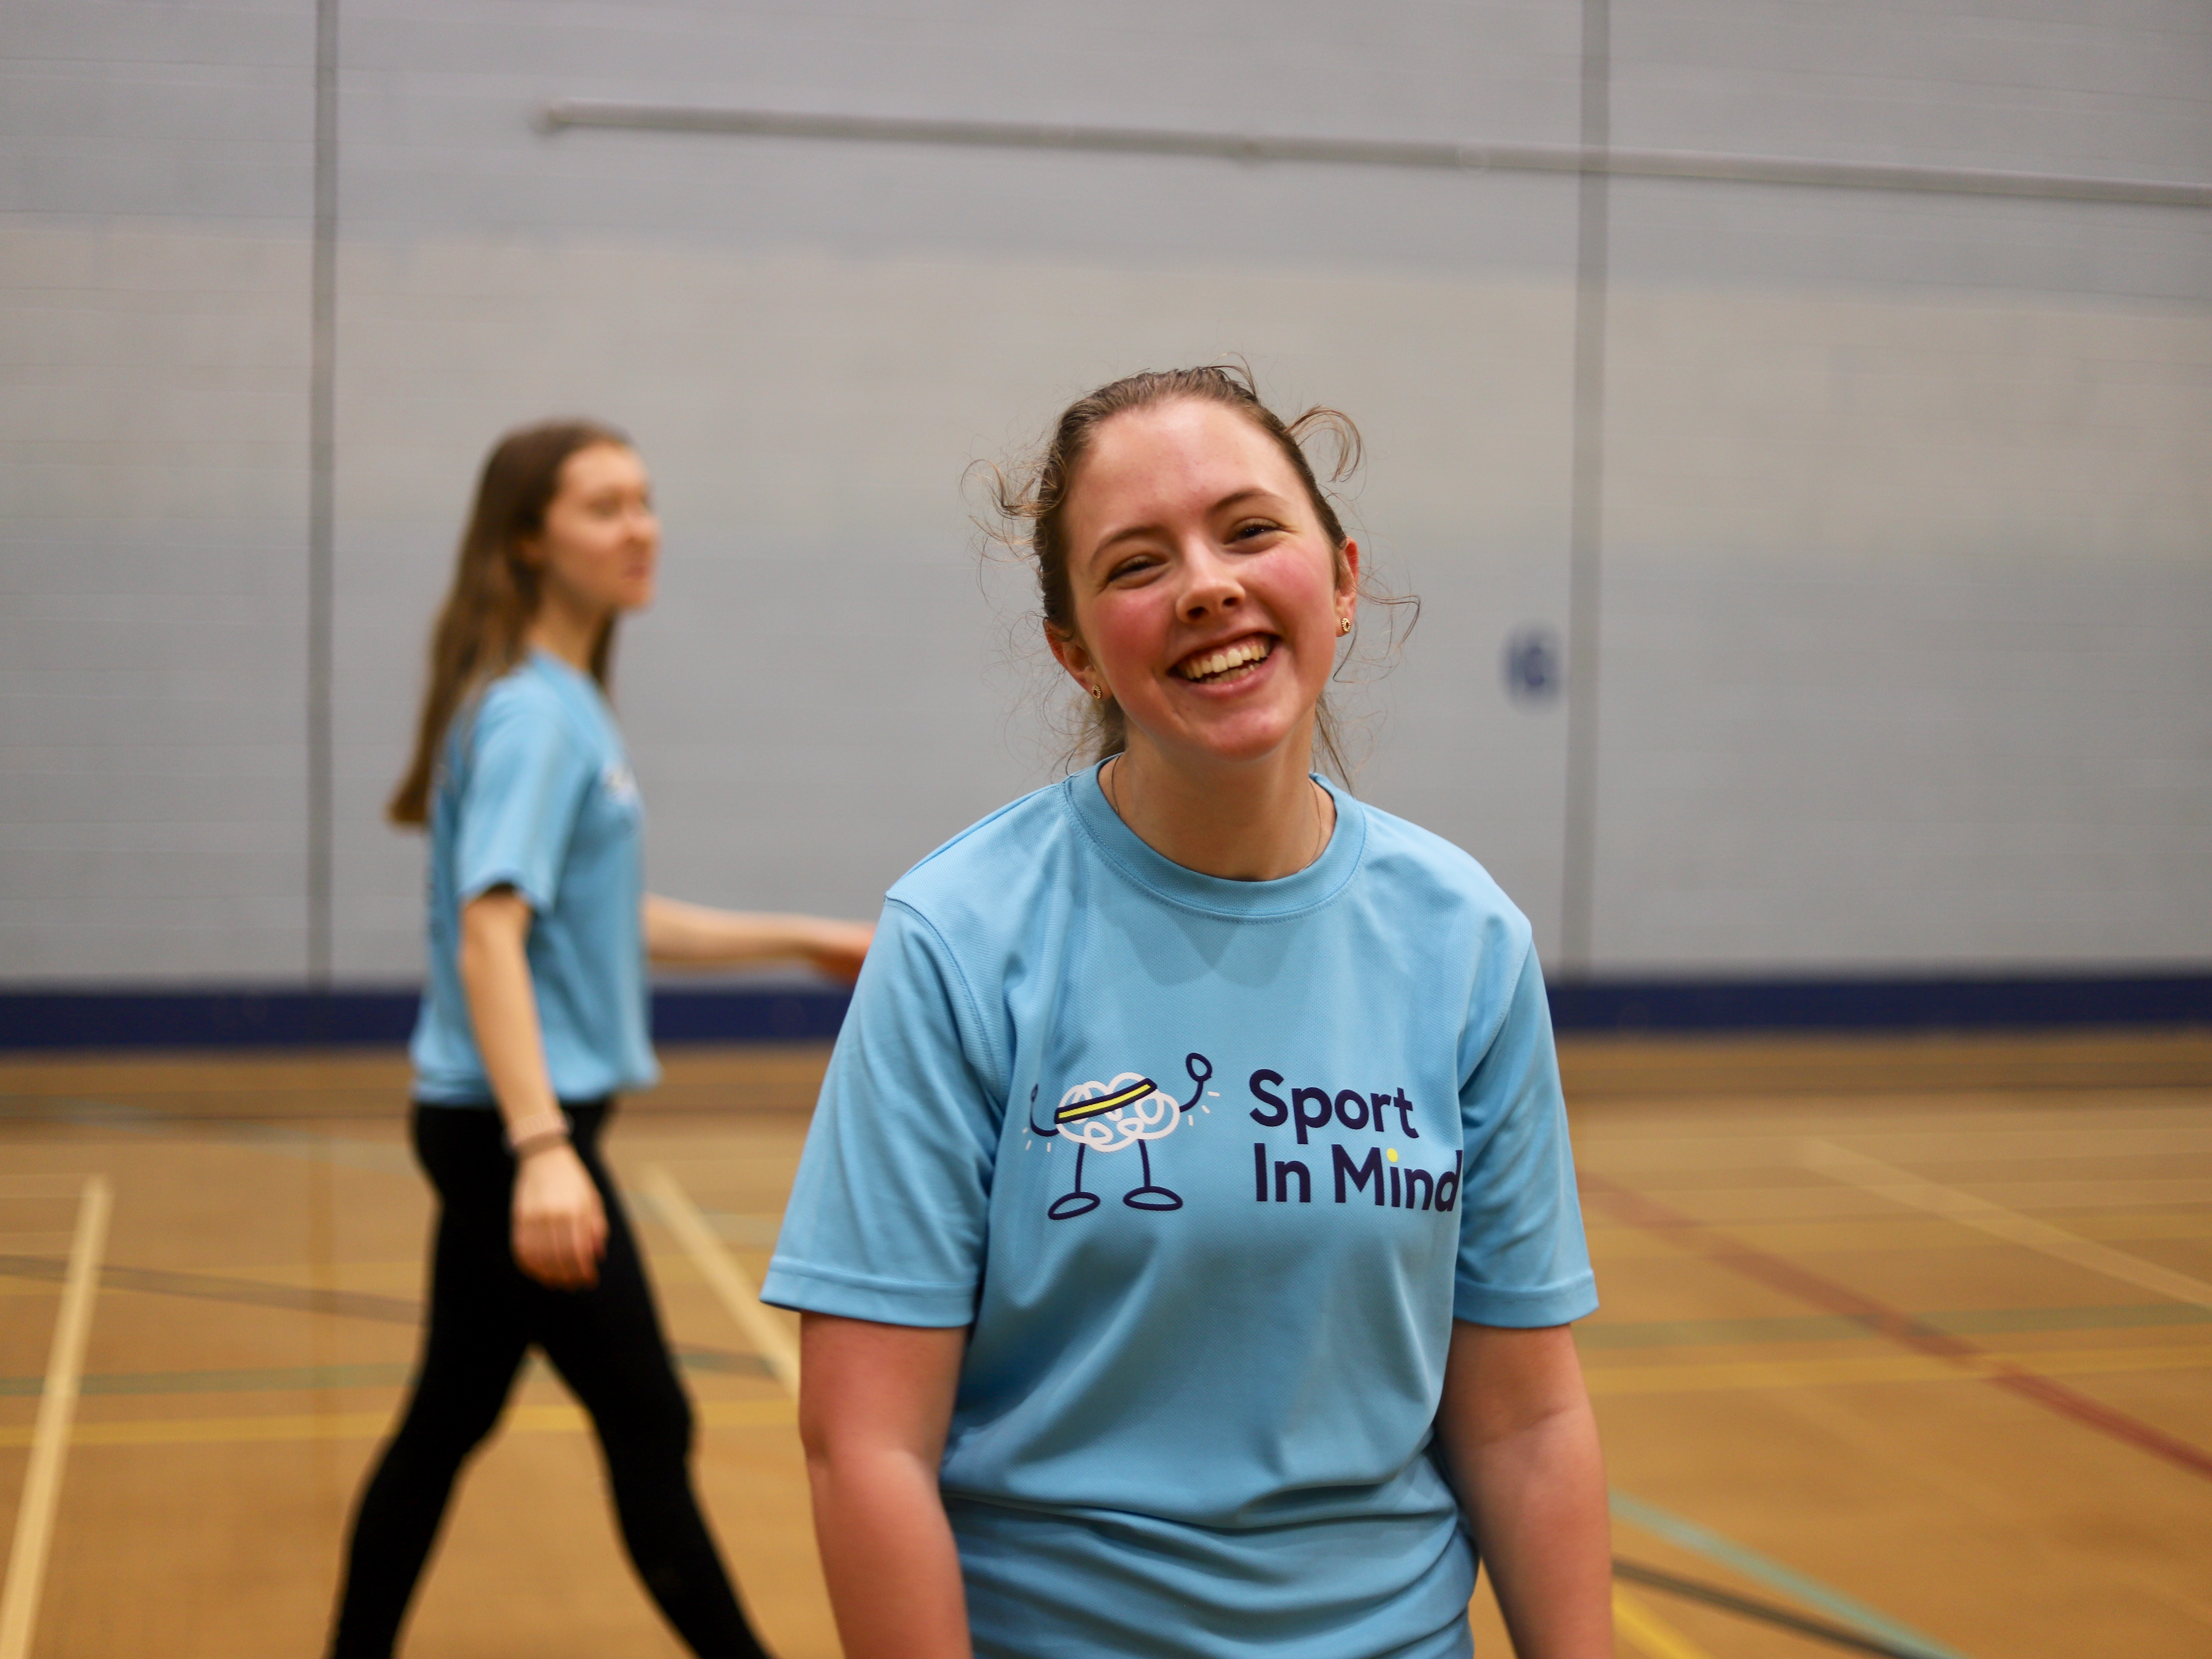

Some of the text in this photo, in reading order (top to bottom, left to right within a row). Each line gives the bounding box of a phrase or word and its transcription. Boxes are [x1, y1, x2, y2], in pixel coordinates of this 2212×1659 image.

[1249, 1069, 1419, 1145] Sport
[1254, 1143, 1463, 1213] In Mind
